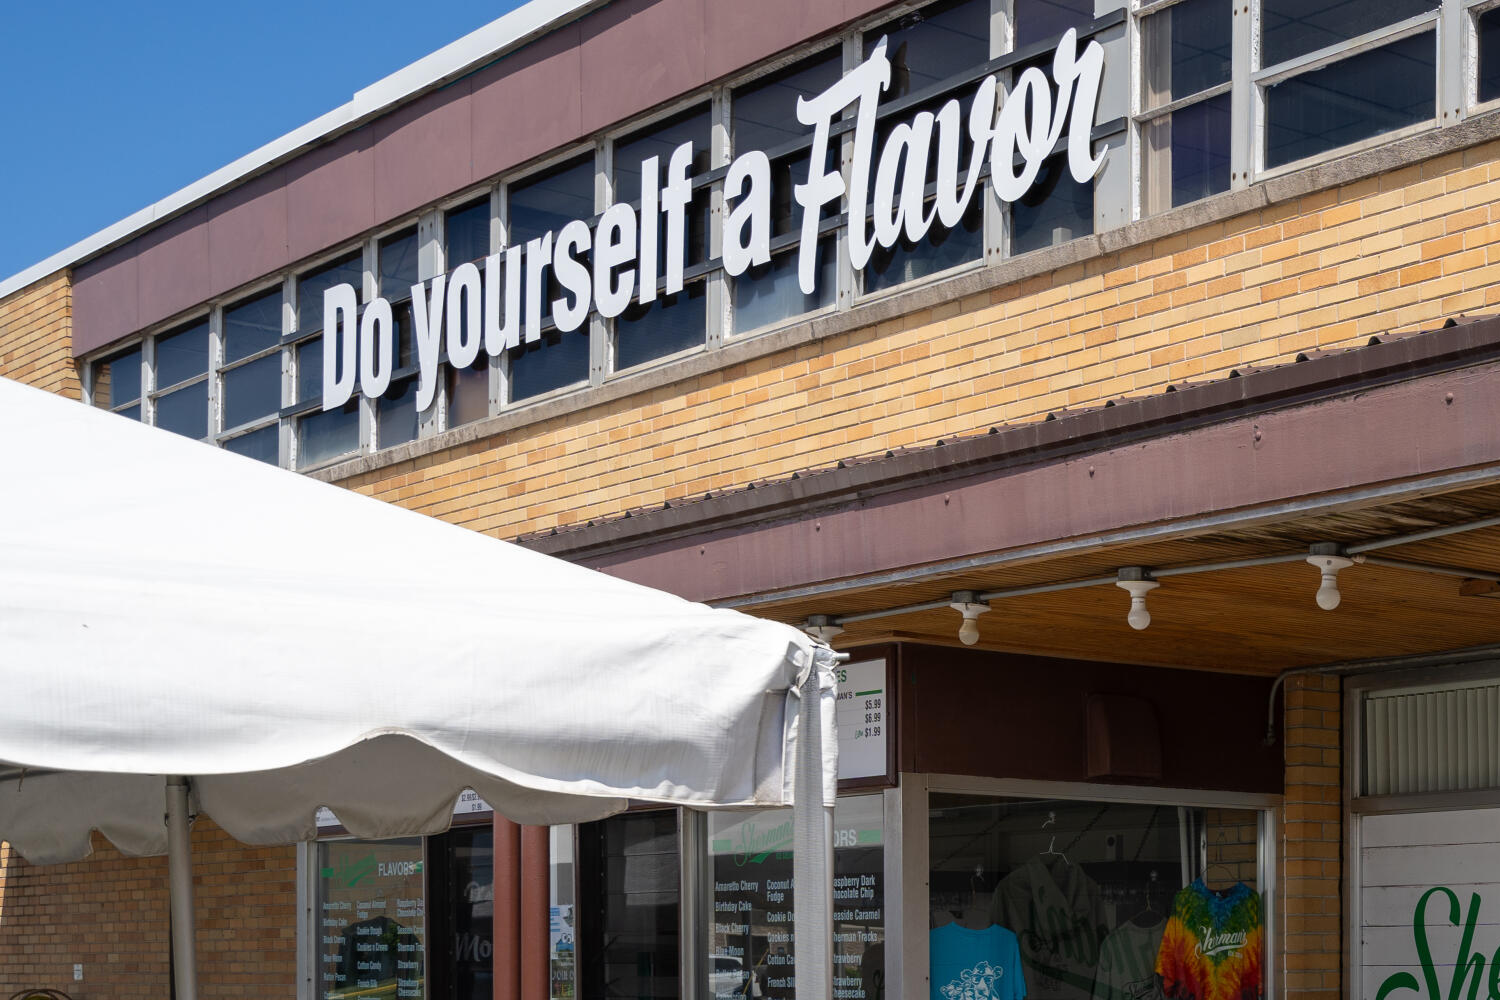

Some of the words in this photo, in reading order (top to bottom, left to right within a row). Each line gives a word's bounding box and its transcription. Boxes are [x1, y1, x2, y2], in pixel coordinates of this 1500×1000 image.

[322, 281, 392, 411] Do
[410, 140, 694, 413] yourself
[721, 149, 772, 277] a
[793, 27, 1110, 295] Flavor
[865, 699, 881, 710] $5.99
[865, 712, 881, 724] $6.99
[865, 726, 881, 738] $1.99
[378, 861, 415, 877] FLAVORS
[715, 880, 740, 892] Amaretto
[740, 880, 758, 894] Cherry
[766, 880, 790, 890] Coconut
[834, 875, 860, 890] aspberry
[860, 874, 876, 886] Dark
[766, 891, 784, 904] Fudge
[833, 887, 860, 899] hocolate
[860, 888, 874, 901] Chip
[715, 901, 738, 914] Birthday
[738, 901, 752, 911] Cake
[766, 912, 786, 923] Cookie
[833, 909, 854, 920] easide
[854, 908, 881, 920] Caramel
[716, 923, 730, 934] Black
[731, 923, 750, 936] Cherry
[767, 932, 790, 942] Cookies
[833, 931, 857, 942] herman
[858, 930, 878, 942] Tracks
[767, 955, 786, 965] Cotton
[833, 953, 862, 966] trawberry
[767, 977, 786, 988] French
[833, 976, 863, 988] trawberry
[833, 988, 866, 999] heesecake
